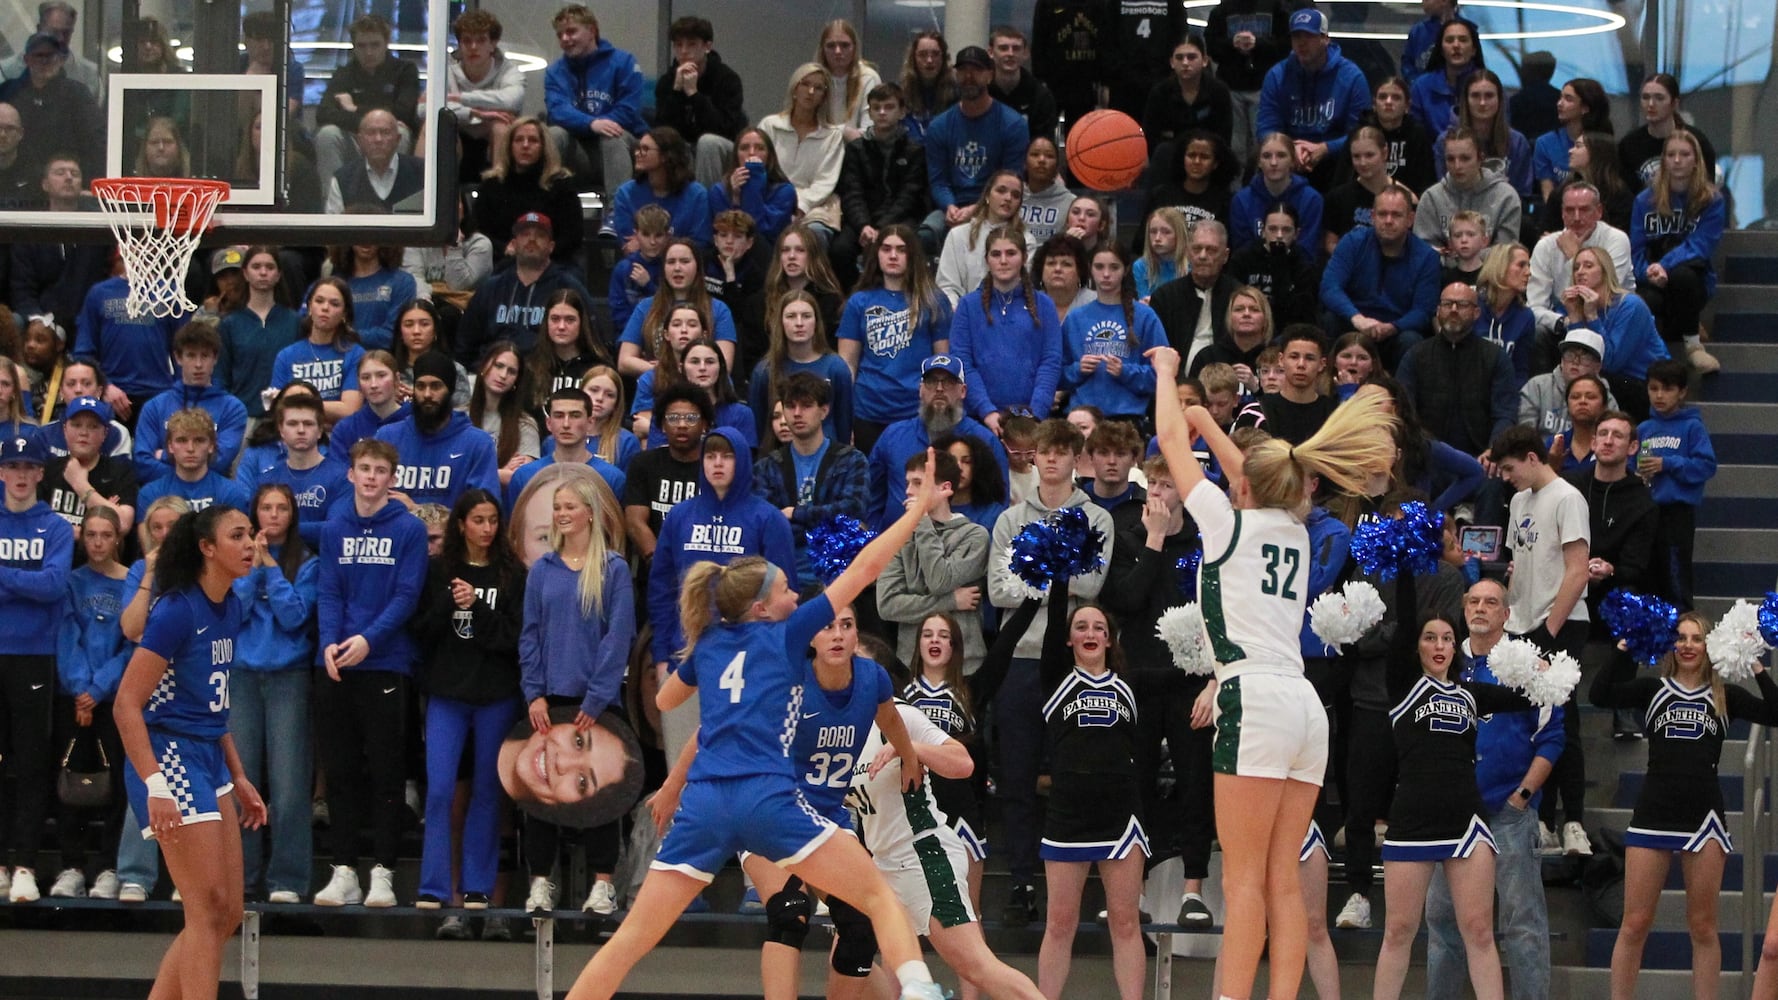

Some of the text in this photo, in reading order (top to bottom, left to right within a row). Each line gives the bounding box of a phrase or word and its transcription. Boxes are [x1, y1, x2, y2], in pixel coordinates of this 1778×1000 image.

[1136, 18, 1151, 38] 4
[292, 360, 344, 379] STATE
[659, 479, 701, 504] BOR
[1261, 544, 1300, 600] 32
[719, 651, 747, 704] 4
[1063, 699, 1131, 723] PANTHERS
[1654, 710, 1718, 736] PANTHERS
[817, 725, 857, 749] BORO
[805, 752, 854, 788] 32
